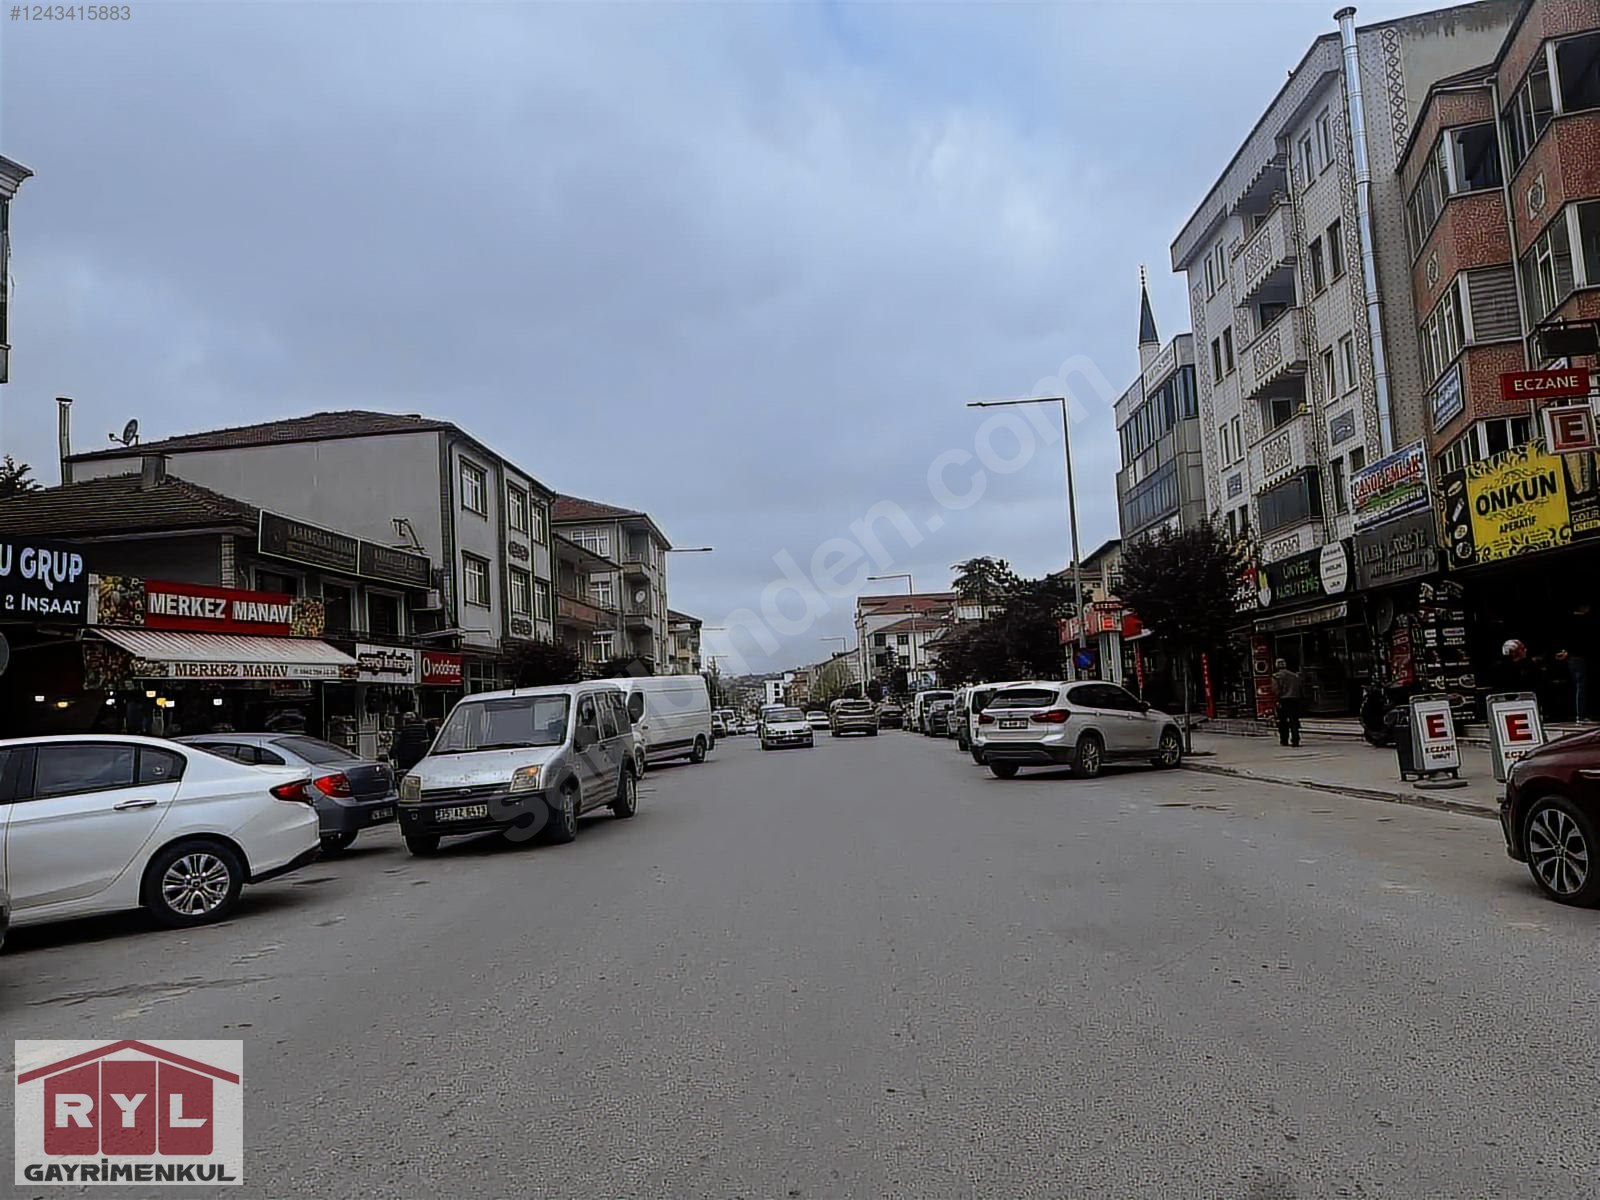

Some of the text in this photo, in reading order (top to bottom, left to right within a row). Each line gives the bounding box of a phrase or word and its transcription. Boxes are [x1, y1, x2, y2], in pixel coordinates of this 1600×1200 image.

[1513, 375, 1579, 392] ECZANE
[1385, 456, 1421, 485] EMLAK
[1476, 471, 1557, 516] ONKUN
[20, 547, 83, 591] GRUP
[148, 591, 227, 619] MERKEZ
[174, 663, 239, 677] MERKEZ
[242, 664, 289, 678] MANAV
[1425, 713, 1448, 739] E
[1505, 713, 1533, 742] E
